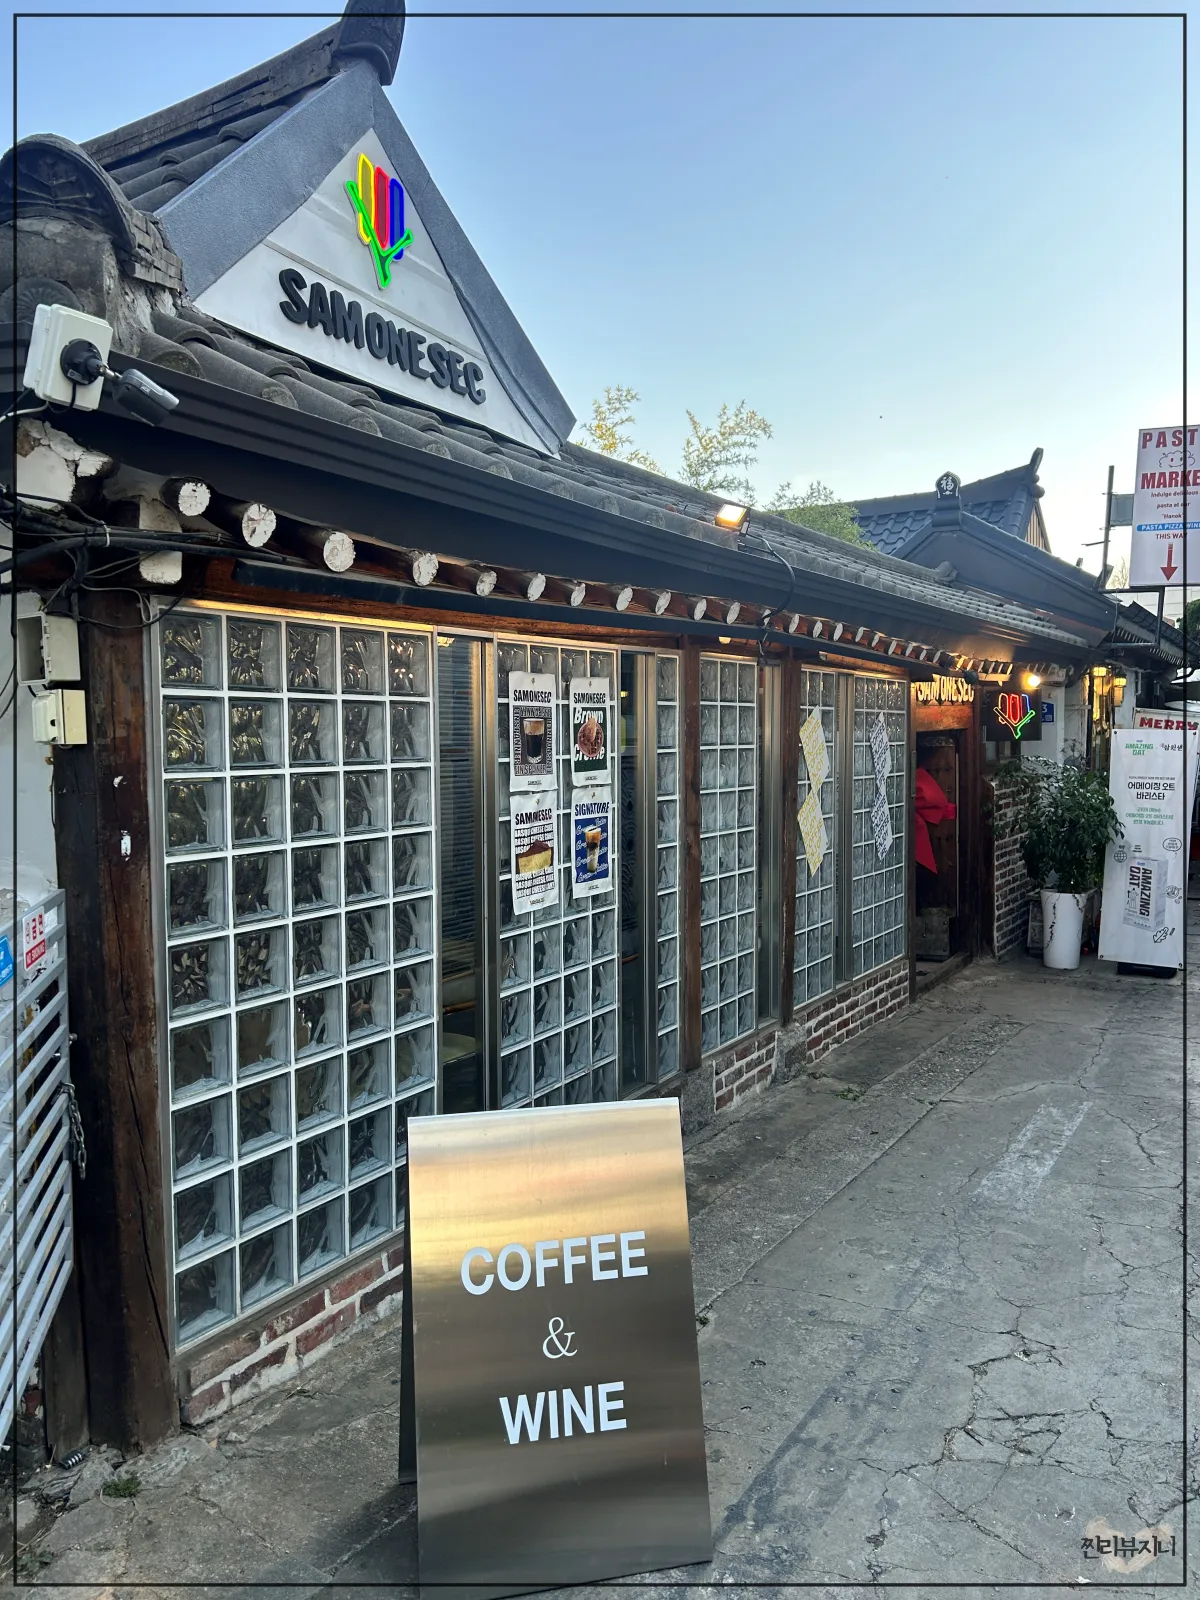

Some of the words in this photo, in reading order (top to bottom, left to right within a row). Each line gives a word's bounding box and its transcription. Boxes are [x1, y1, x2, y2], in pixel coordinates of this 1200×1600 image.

[279, 268, 486, 405] SAMONESEC
[941, 476, 954, 490] 福
[1151, 491, 1172, 499] Indulge
[1173, 489, 1198, 497] deliious
[1157, 502, 1172, 510] pasta
[1142, 523, 1163, 531] PASTA
[1164, 522, 1183, 530] PIZZA
[513, 689, 552, 704] SAMONESEC
[573, 692, 606, 704] SAMONESEC
[574, 706, 604, 724] Brown
[1139, 717, 1199, 731] MERRY
[574, 744, 605, 761] Cre
[1128, 782, 1160, 790] 어메이징
[1162, 782, 1176, 790] 오트
[1136, 792, 1165, 800] 바리스타
[575, 802, 610, 816] SIGNATURE
[1129, 866, 1141, 888] OAT
[1139, 868, 1152, 916] AMAZING
[460, 1230, 648, 1296] COFFEE
[542, 1316, 578, 1359] &
[499, 1381, 627, 1445] WINE
